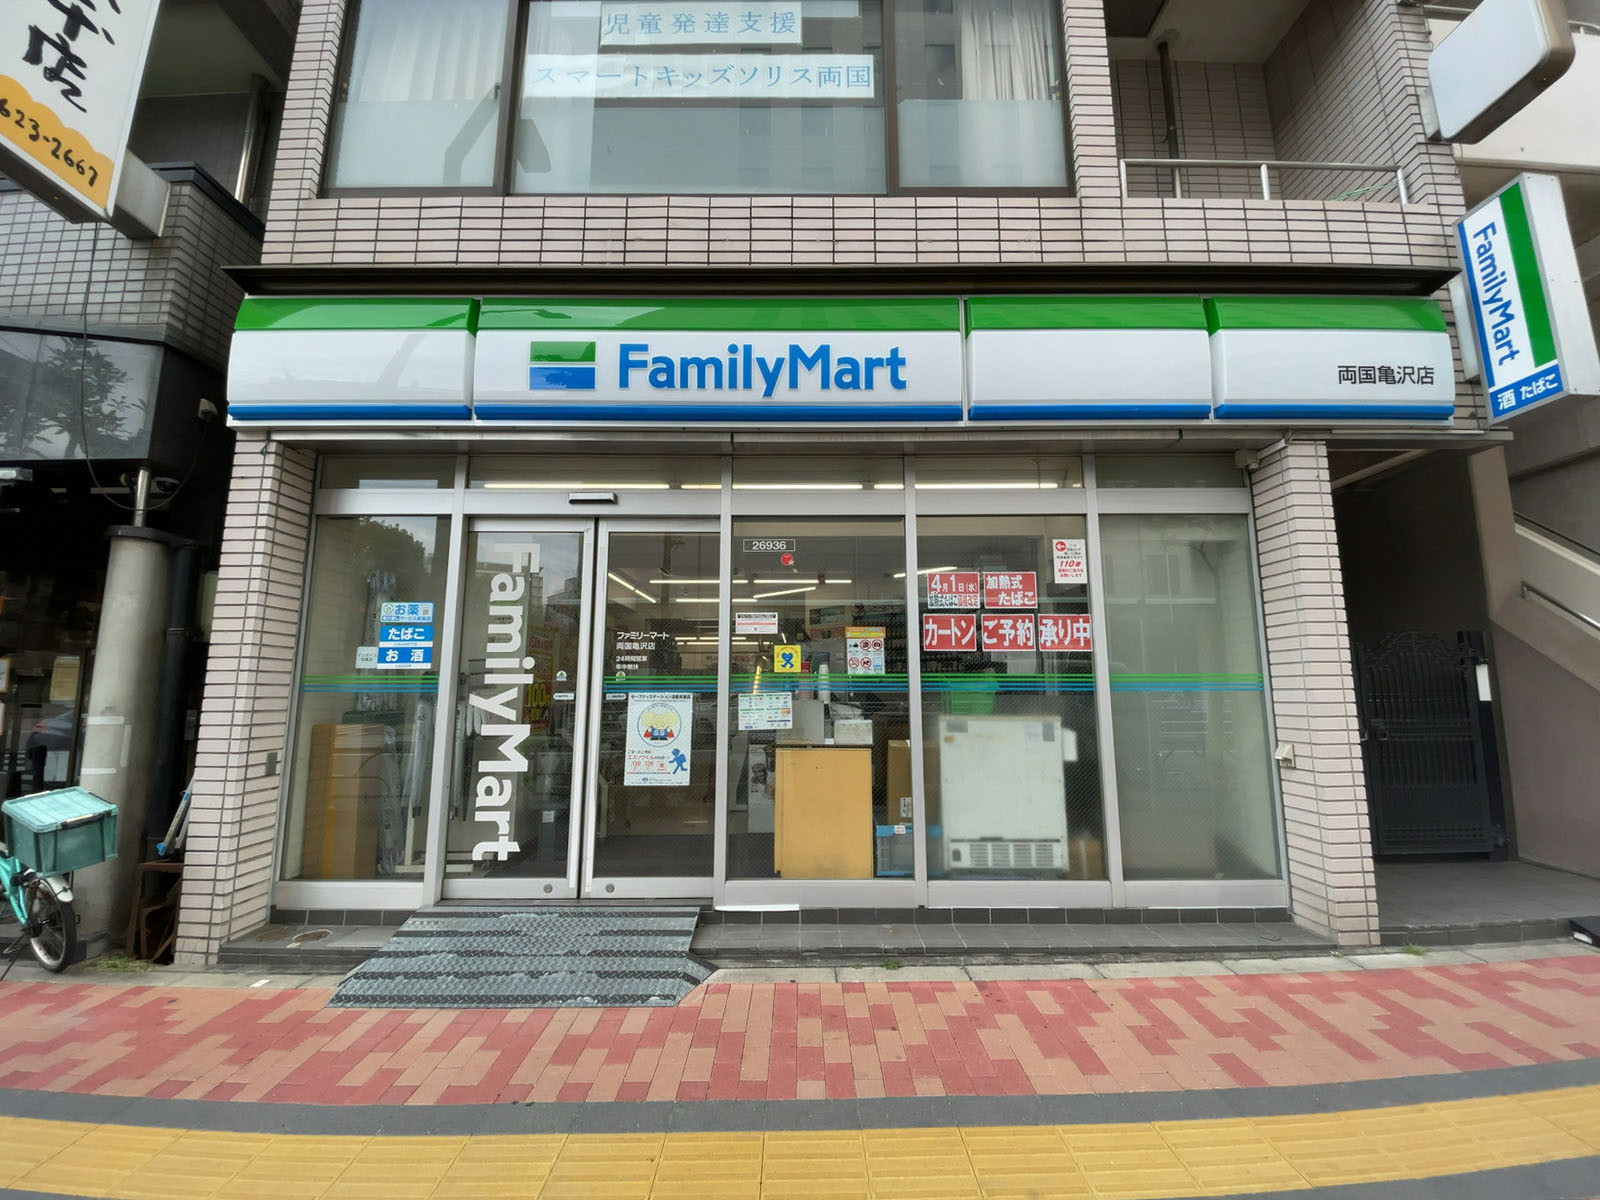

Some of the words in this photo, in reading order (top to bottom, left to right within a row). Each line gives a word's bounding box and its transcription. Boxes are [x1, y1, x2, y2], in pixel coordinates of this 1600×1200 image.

[604, 11, 797, 35] 児童発達支援
[533, 64, 872, 89] スマートキッズソリス両国
[1472, 221, 1521, 366] FamilyMart
[618, 343, 907, 398] FamilyMart
[1337, 365, 1434, 385] 両国亀沢店
[1519, 373, 1559, 400] たばこ
[1497, 389, 1516, 411] 酒
[752, 540, 787, 550] 26936
[986, 574, 1023, 589] 加熱式
[998, 591, 1036, 606] たばこ
[394, 604, 419, 616] お薬
[388, 627, 425, 640] たばこ
[616, 631, 670, 640] ファミリーマート
[925, 618, 974, 646] カートン
[982, 618, 1034, 647] ご予約
[1039, 618, 1091, 647] 承り中
[616, 641, 656, 650] 両国亀沢店
[615, 655, 648, 663] 24時間営業
[468, 543, 541, 861] FamilyMart
